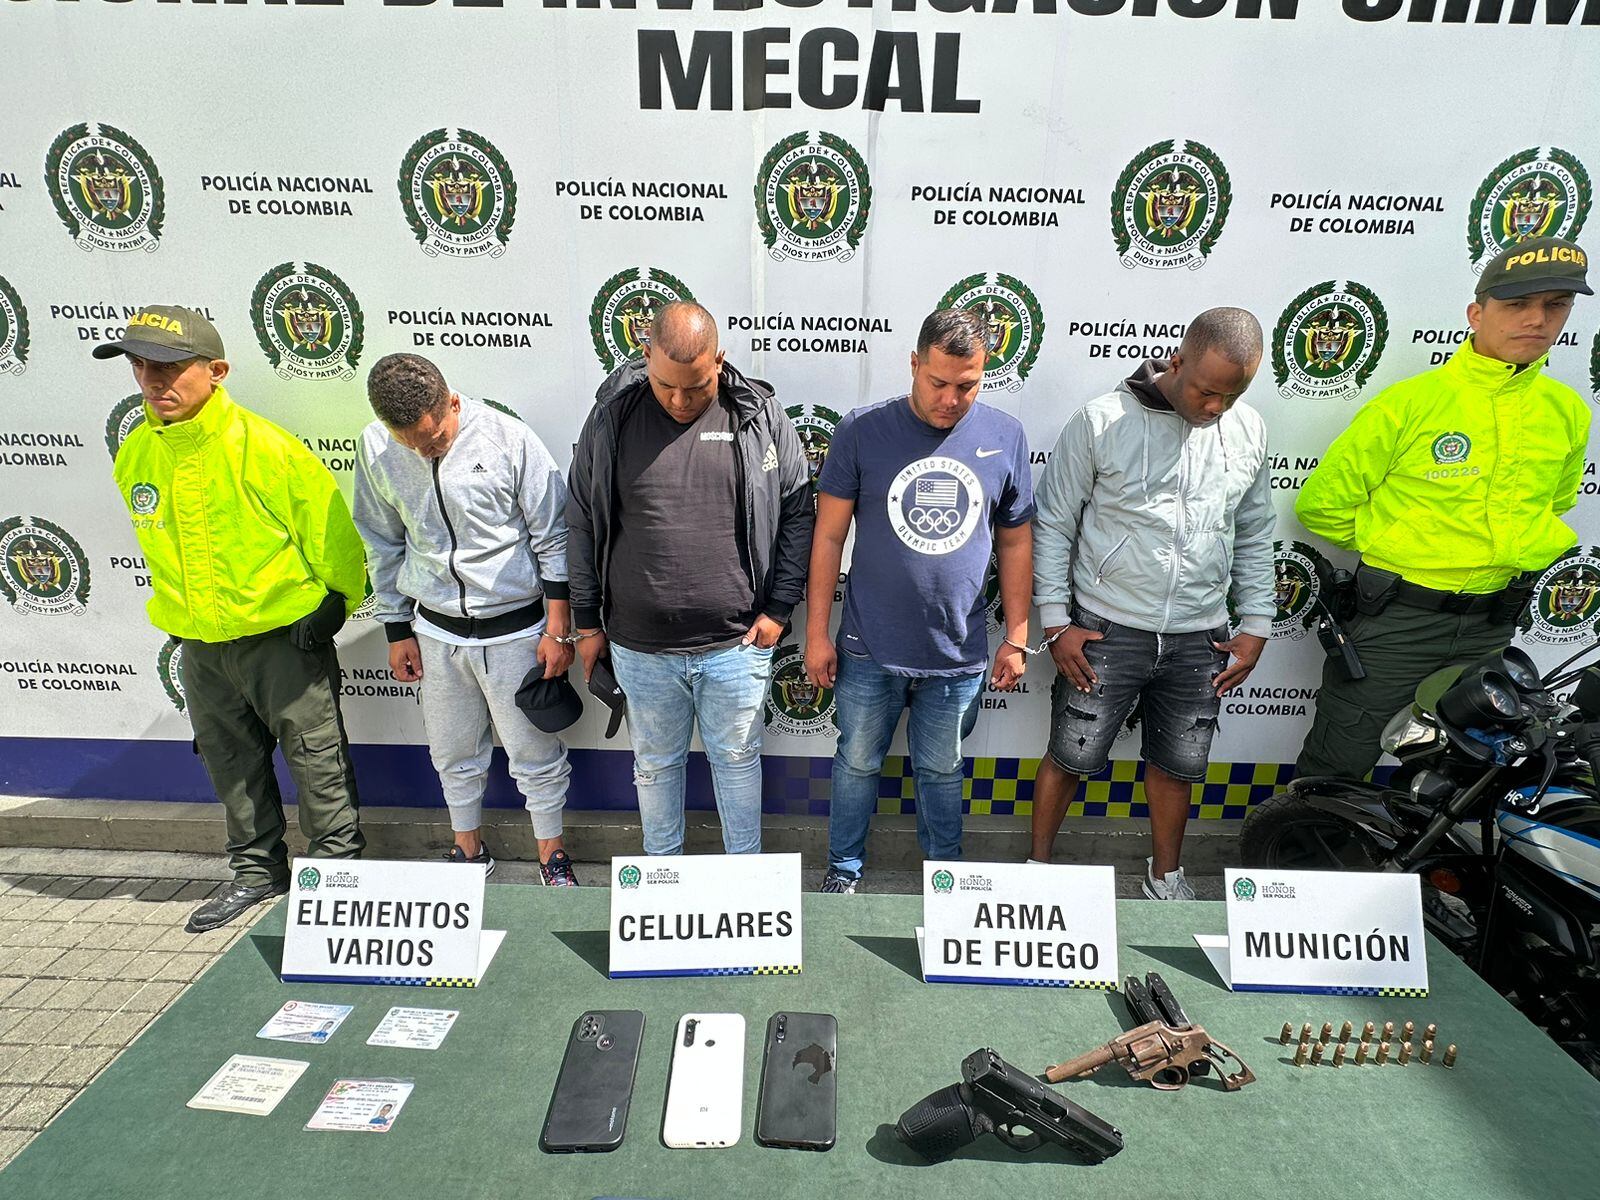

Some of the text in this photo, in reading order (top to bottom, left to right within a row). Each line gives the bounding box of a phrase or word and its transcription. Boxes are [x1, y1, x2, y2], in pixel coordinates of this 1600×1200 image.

[638, 27, 981, 113] MECAL
[60, 138, 150, 196] REPUBLICA DE COLOMBIA
[414, 148, 440, 199] REPUBLICA
[472, 150, 502, 202] COLOMBIA
[201, 172, 373, 193] POLICÍA NACIONAL
[556, 177, 727, 198] POLICÍA NACIONAL
[768, 151, 799, 203] REPUBLICA
[831, 153, 857, 206] COLOMBIA
[1126, 159, 1162, 211] REPUBLICA
[1194, 162, 1216, 214] COLOMBIA
[912, 182, 1085, 203] POLICÍA NACIONAL
[1271, 190, 1444, 211] POLICÍA NACIONAL
[1483, 167, 1525, 219] REPUBLICA
[1557, 169, 1575, 221] COLOMBIA
[229, 200, 352, 216] DE COLOMBIA
[581, 205, 704, 221] DE COLOMBIA
[934, 210, 1058, 227] DE COLOMBIA
[72, 207, 150, 237] POLICIA NACIONAL
[422, 212, 500, 242] POLICIA NACIONAL
[773, 216, 853, 246] POLICIA NACIONAL
[1290, 218, 1414, 234] DE COLOMBIA
[118, 236, 146, 249] PATRIA
[464, 241, 493, 254] PATRIA
[1128, 224, 1208, 254] POLICIA NACIONAL
[812, 245, 842, 259] PATRIA
[1163, 253, 1194, 266] PATRIA
[1506, 246, 1586, 271] POLICIA
[51, 301, 120, 320] POLICÍA
[265, 280, 289, 327] REPUBLICA
[319, 282, 350, 329] COLOMBIA
[604, 286, 631, 333] REPUBLICA
[130, 312, 184, 336] LICIA
[388, 307, 552, 326] POLICÍA NACIONAL
[728, 312, 892, 332] POLICÍA NACIONAL
[1007, 293, 1030, 341] COLOMBIA
[1286, 299, 1323, 346] REPUBLICA
[1354, 301, 1373, 348] COLOMBIA
[78, 327, 100, 340] DE
[1069, 319, 1136, 337] POLICÍA
[1412, 327, 1469, 344] POLICÍ
[413, 333, 531, 347] DE COLOMBIA
[752, 338, 868, 353] DE COLOMBIA
[274, 339, 349, 366] POLICIA NACIONAL
[1089, 344, 1179, 359] DE COLOM
[316, 365, 343, 377] PATRIA
[985, 352, 1024, 378] NACIONAL
[1288, 358, 1364, 385] POLICIA NACIONAL
[983, 377, 1012, 389] PATRIA
[1319, 384, 1349, 396] PATRIA
[0, 433, 84, 447] NACIONAL
[900, 460, 975, 486] UNITED STATES
[898, 525, 967, 552] OLYMPIC TEAM
[46, 533, 77, 573] COLOMBIA
[9, 581, 77, 604] POLICIA NACIONAL
[50, 603, 75, 613] PATRIA
[1272, 607, 1310, 628] NACIONAL
[1558, 632, 1587, 642] PATRIA
[57, 663, 137, 675] NACIONAL
[18, 679, 121, 691] DE COLOMBIA
[1249, 688, 1319, 700] NACIONA
[1226, 704, 1306, 716] COLOMBIA
[802, 725, 827, 734] PATRIA
[326, 875, 359, 883] HONOR
[959, 878, 992, 886] HONOR
[1262, 886, 1296, 894] HONOR
[1502, 884, 1532, 910] POWER
[297, 900, 469, 929] ELEMENTOS
[974, 903, 1066, 931] ARMA
[619, 911, 792, 941] CELULARES
[327, 938, 433, 966] VARIOS
[944, 939, 1098, 970] DE FUEGO
[1245, 928, 1409, 962] MUNICIÓN
